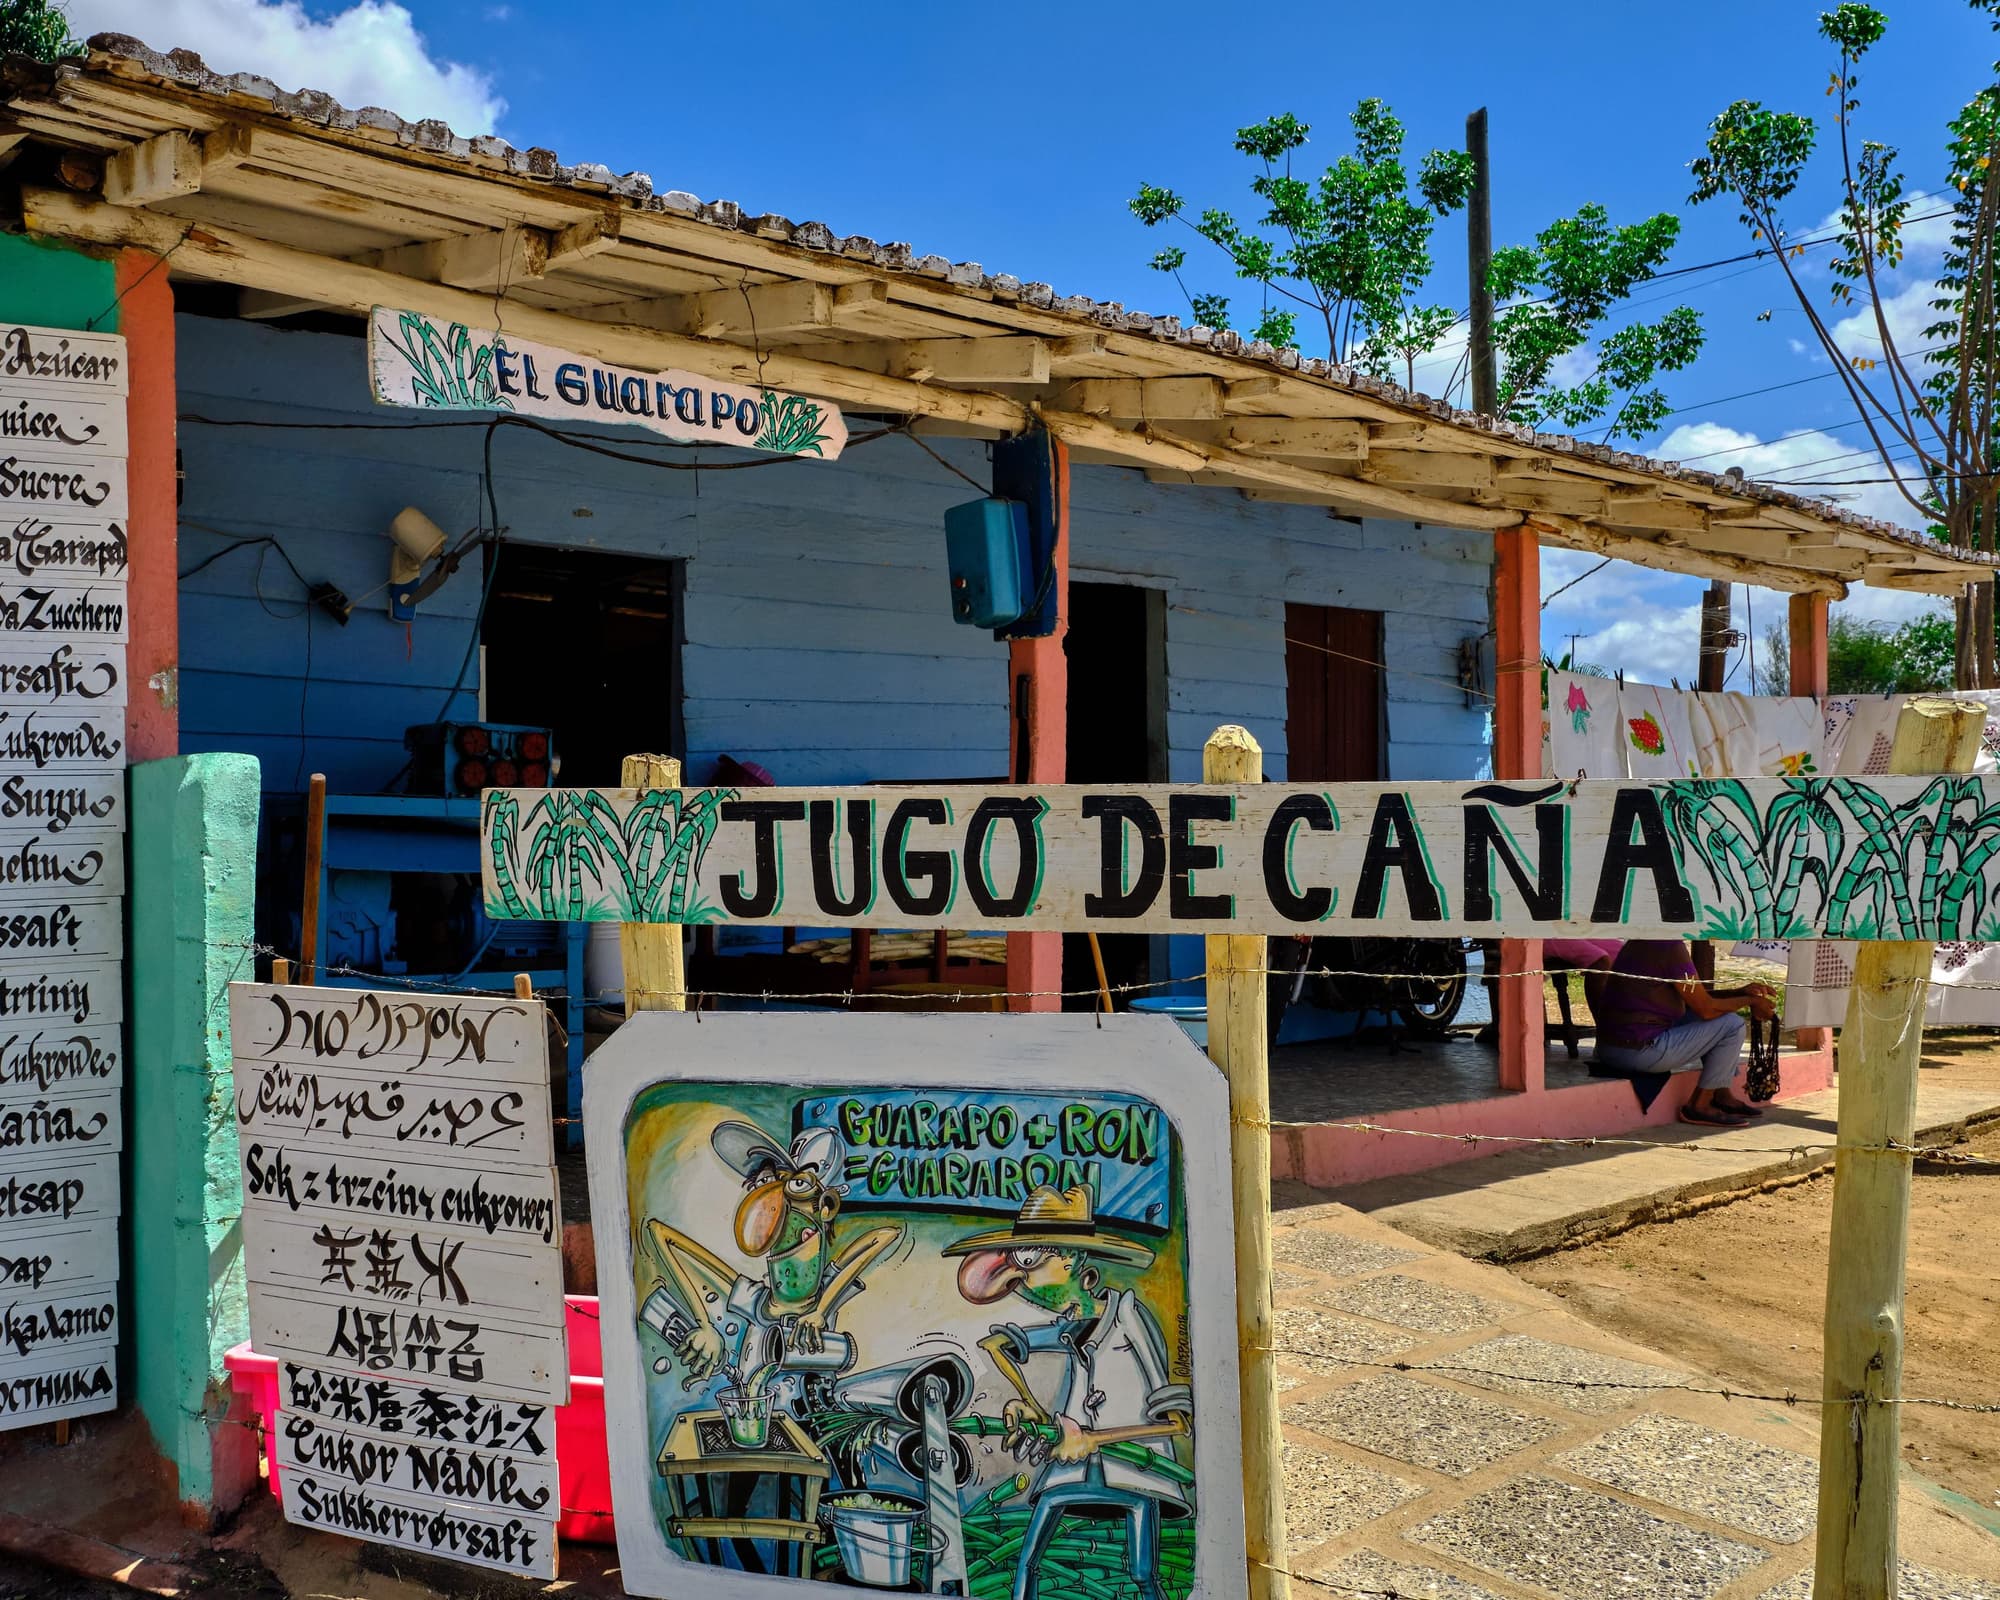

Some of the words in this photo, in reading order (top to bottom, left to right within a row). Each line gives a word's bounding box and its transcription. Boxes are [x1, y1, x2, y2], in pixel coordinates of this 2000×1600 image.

[16, 586, 123, 632] Zucchero
[719, 794, 1049, 918] JUGO
[1081, 794, 1236, 919] DE
[1262, 780, 1698, 923] CAÑA
[0, 1100, 108, 1148] aña
[838, 1099, 1019, 1151] GUARAPO
[1061, 1103, 1158, 1166] RON
[245, 1142, 302, 1212] Sok
[302, 1171, 321, 1201] z
[297, 1477, 537, 1567] Sukkerrørsaft
